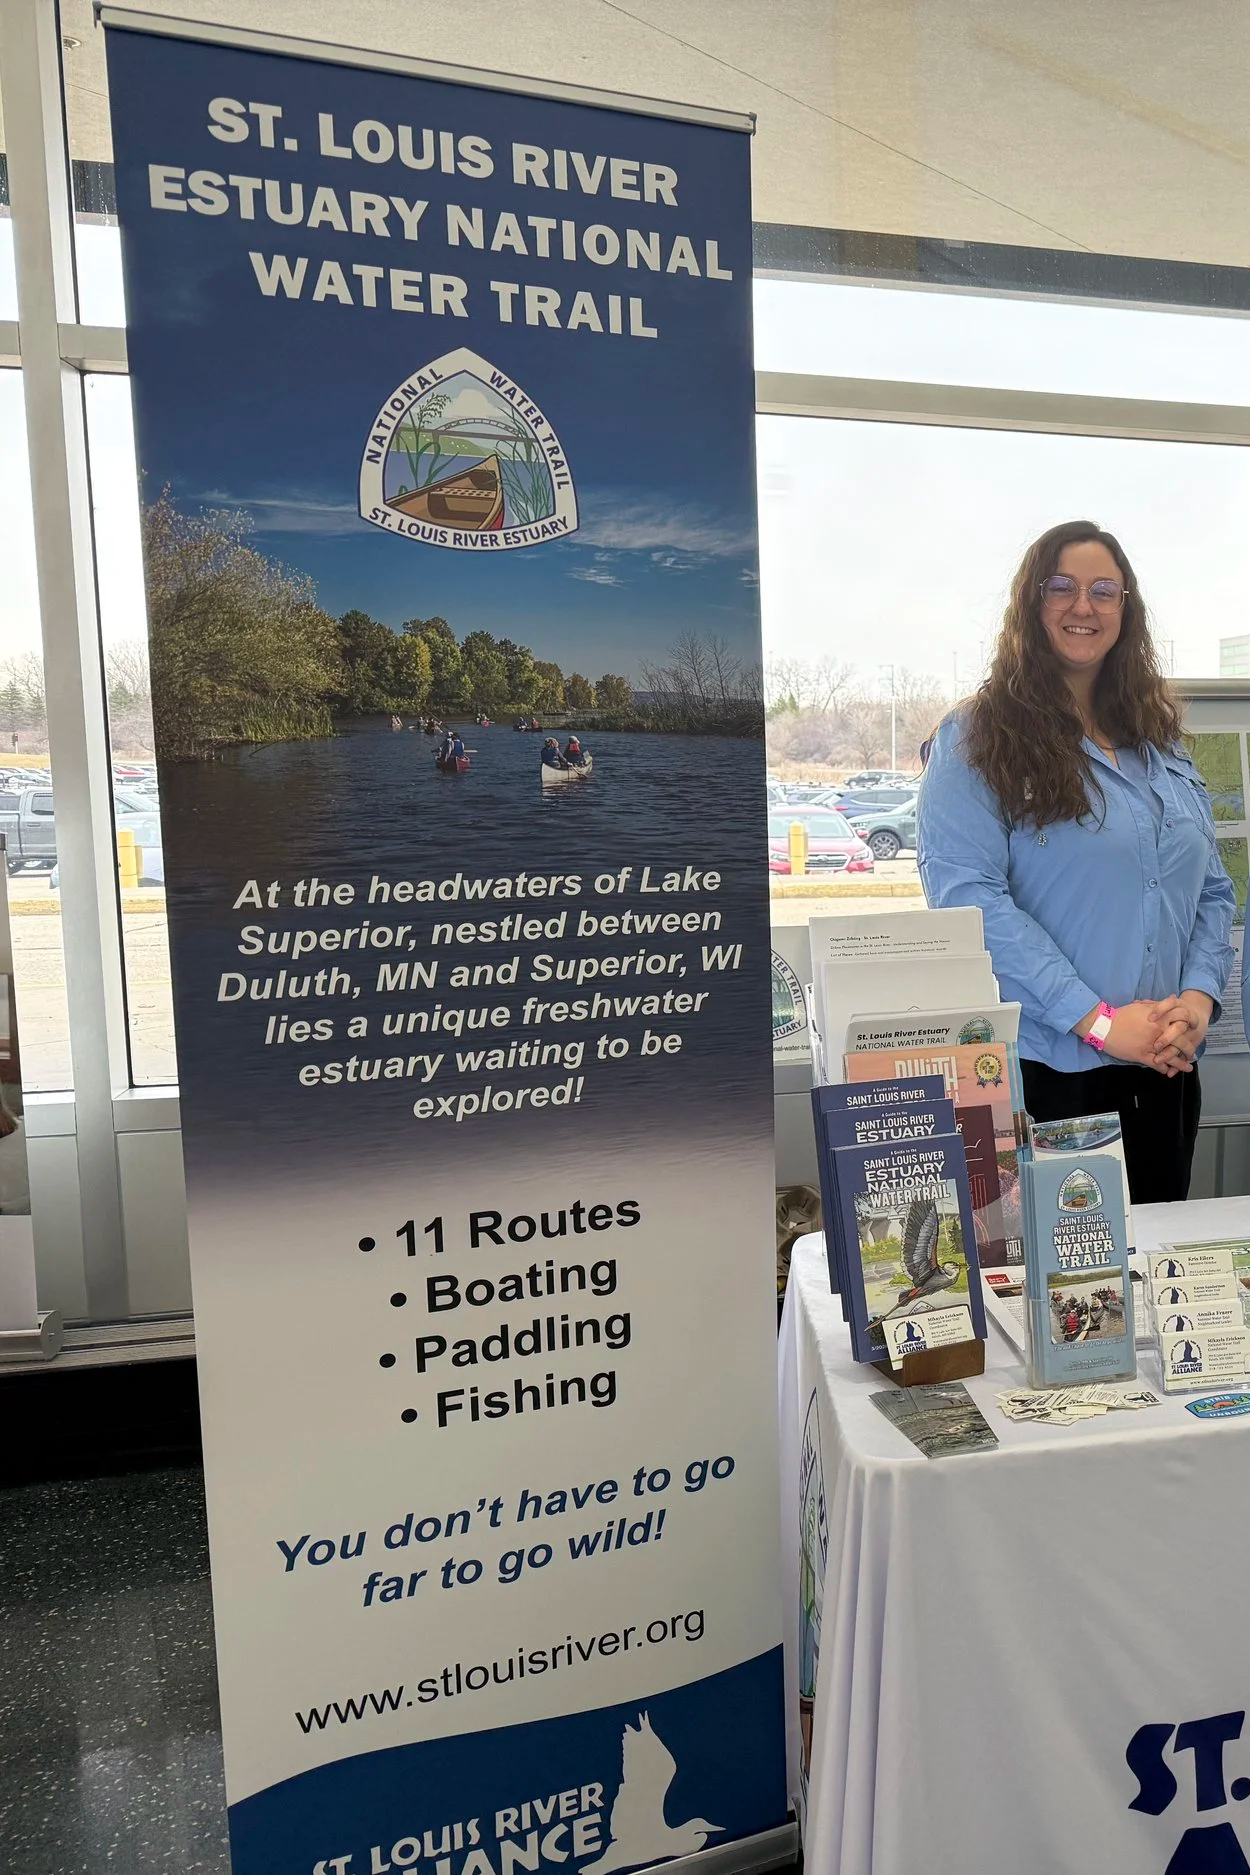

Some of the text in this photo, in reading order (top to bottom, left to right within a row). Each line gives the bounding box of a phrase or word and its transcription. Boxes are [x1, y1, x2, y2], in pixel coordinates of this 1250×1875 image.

[207, 97, 678, 206] ST. LOUIS RIVER
[147, 163, 733, 281] ESTUARY NATIONAL
[248, 251, 658, 339] WATER TRAIL
[366, 367, 443, 466] NATIONAL
[489, 370, 570, 492] WATER TRAIL
[368, 506, 570, 549] ST. LOUIS RIVER ESTUARY
[232, 865, 722, 910] At the headwaters of Lake
[237, 905, 723, 960] Superior, nestled between
[217, 943, 743, 1003] Duluth, MN and Superior, WI
[772, 953, 802, 1006] TER TRAIL
[265, 988, 710, 1046] lies a unique freshwater
[773, 1020, 802, 1038] TUARY
[857, 1033, 868, 1041] St.
[870, 1031, 892, 1040] Louis
[894, 1029, 917, 1039] River
[918, 1027, 951, 1037] Estuary
[298, 1028, 683, 1088] estuary waiting to be
[855, 1037, 947, 1050] NATIONAL WATER TRAIL
[412, 1077, 585, 1123] explored!
[846, 1089, 926, 1106] SAINT LOUIS RIVER
[855, 1114, 935, 1131] SAINT LOUIS RIVER
[856, 1124, 936, 1144] ESTUARY
[864, 1150, 945, 1170] SAINT LOUIS RIVER
[865, 1161, 946, 1182] ESTUARY
[867, 1173, 947, 1193] NATIONAL
[870, 1184, 951, 1208] WATER TRAIL
[396, 1197, 642, 1257] 11 Routes
[1053, 1230, 1112, 1245] NATIONAL
[1054, 1222, 1110, 1235] RIVER ESTUARY
[1060, 1214, 1104, 1226] SAINT LOUIS
[1055, 1239, 1115, 1257] WATER
[1058, 1252, 1110, 1269] TRAIL
[426, 1258, 618, 1313] Boating
[415, 1311, 633, 1374] Paddling
[897, 1344, 927, 1355] ALLIANCE
[1172, 1366, 1203, 1375] ALLIANCE
[437, 1369, 617, 1428] Fishing
[276, 1530, 367, 1573] You
[516, 1477, 619, 1523] have
[632, 1465, 671, 1495] to
[684, 1454, 736, 1493] go
[362, 1509, 667, 1608] far to go wild!
[295, 1608, 706, 1735] www.stlouisriver.org
[312, 1782, 604, 1875] ST LOUIS RIVER
